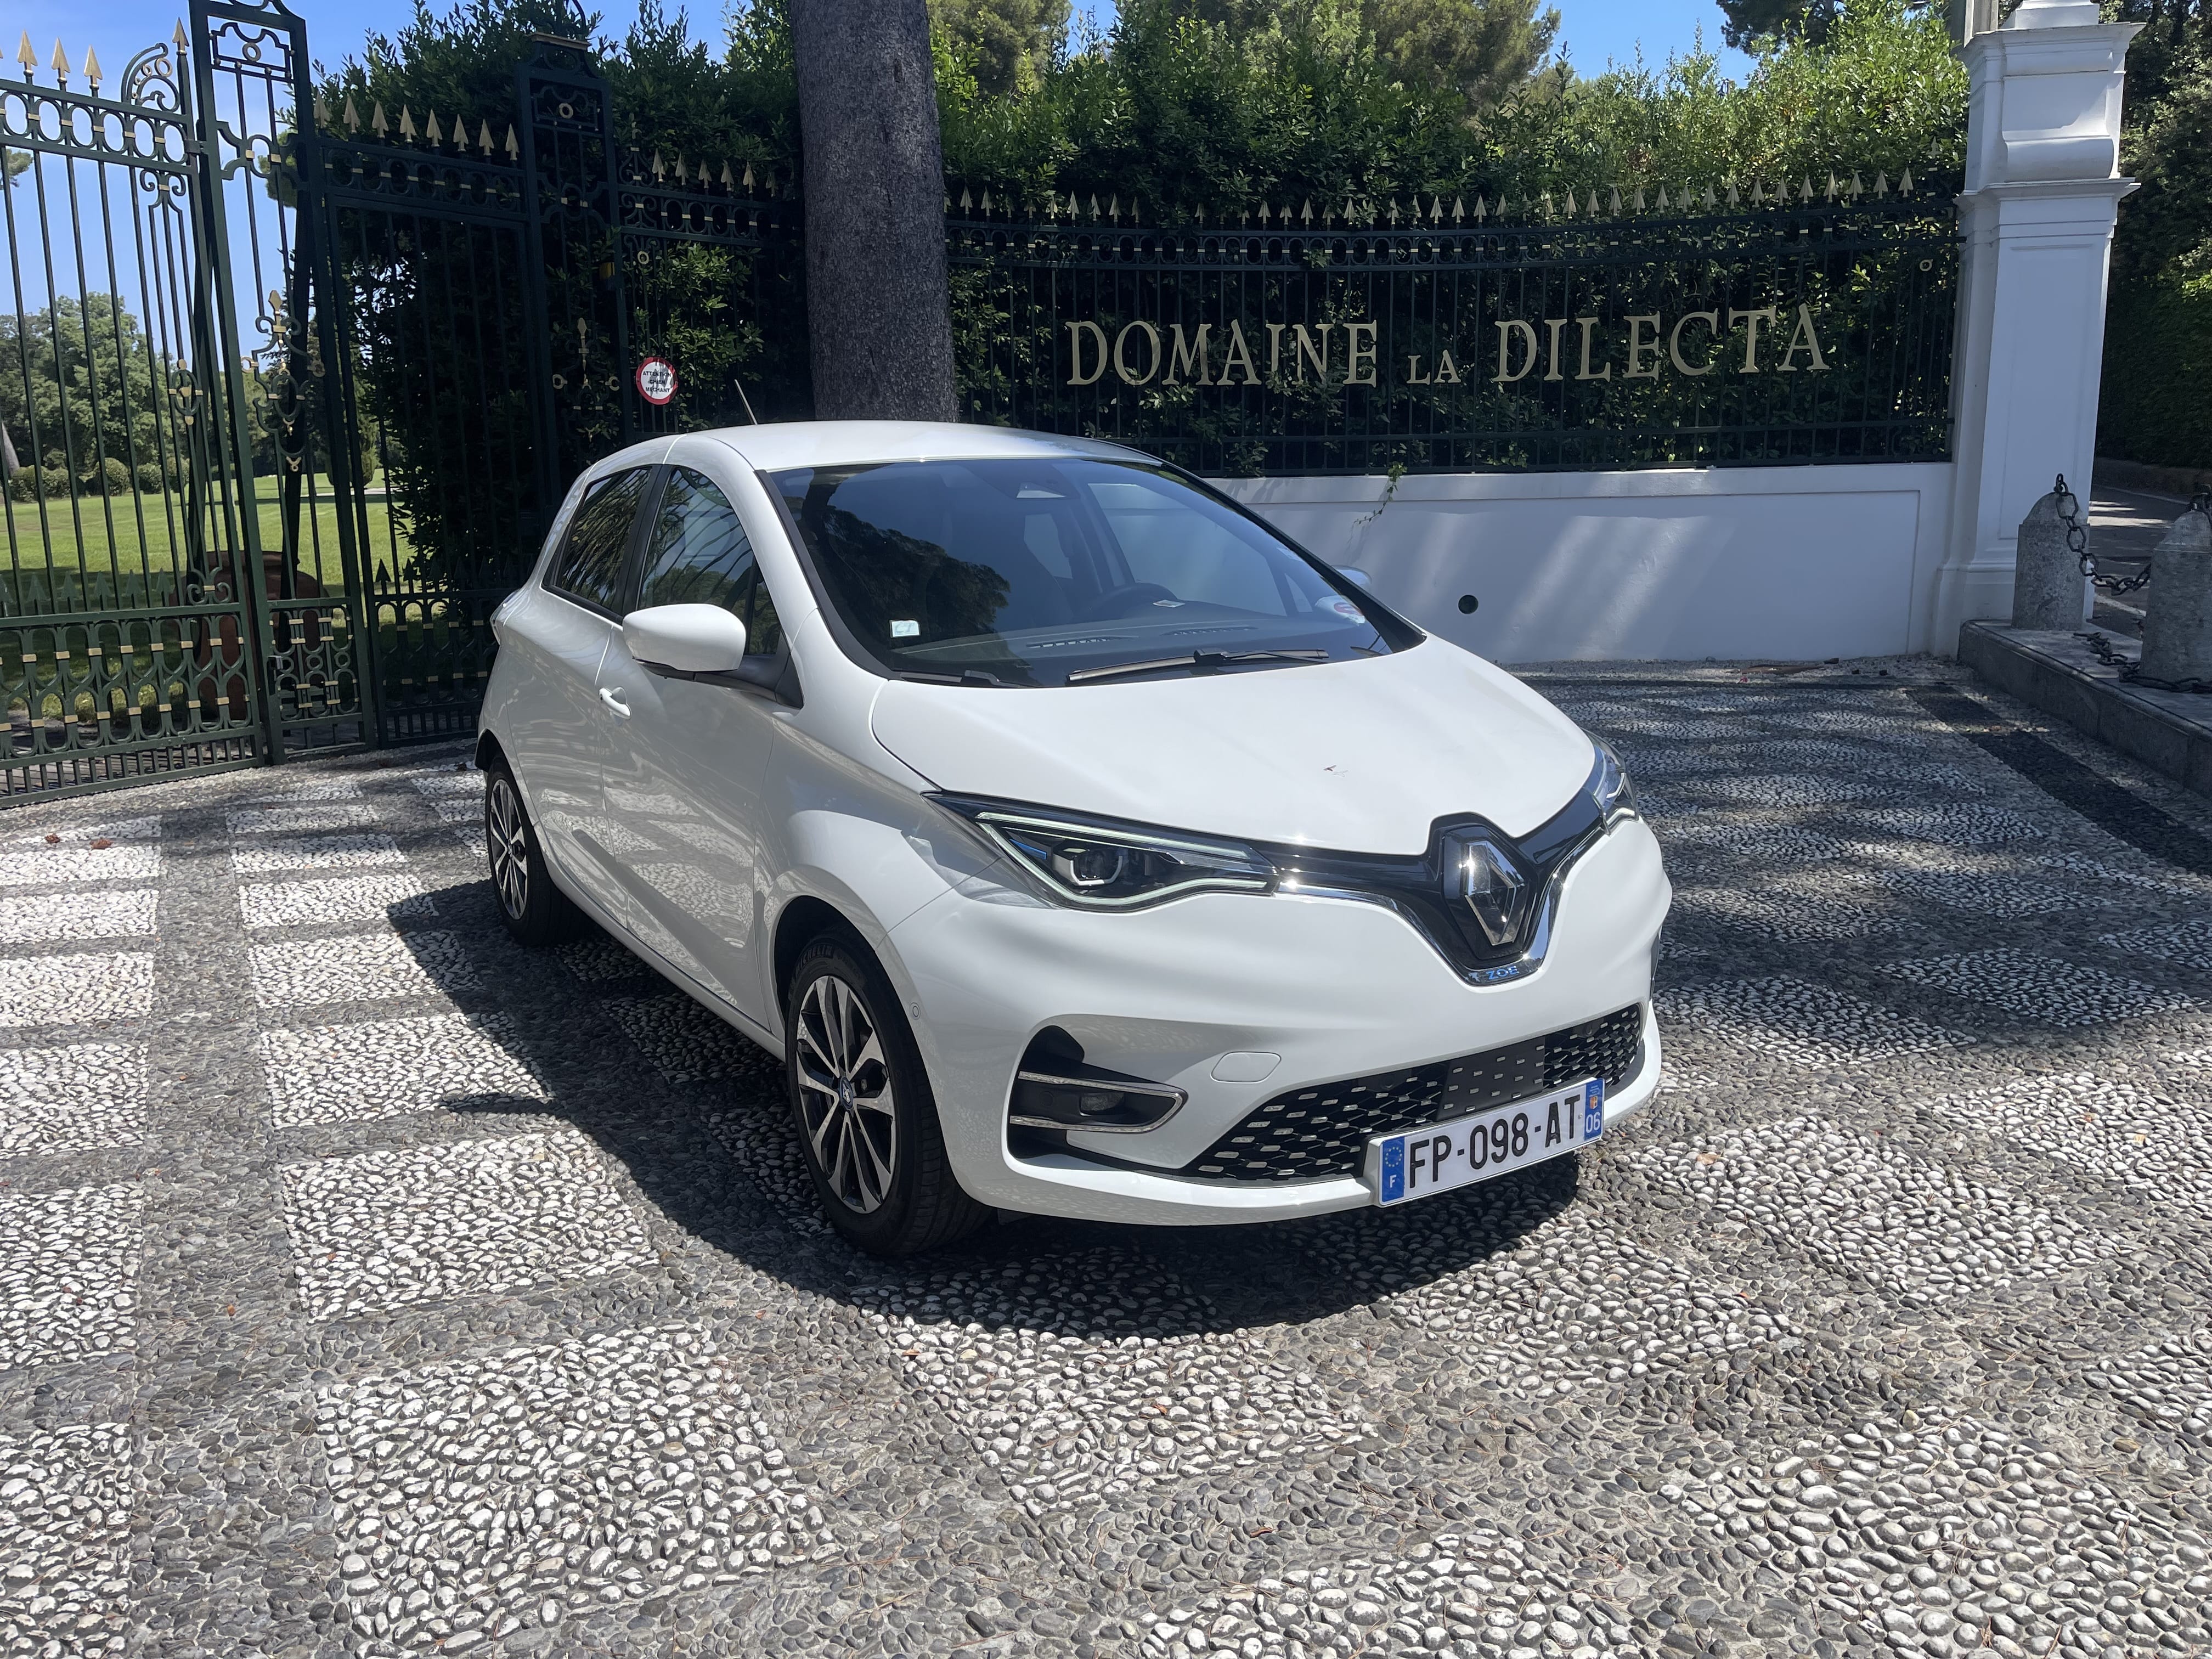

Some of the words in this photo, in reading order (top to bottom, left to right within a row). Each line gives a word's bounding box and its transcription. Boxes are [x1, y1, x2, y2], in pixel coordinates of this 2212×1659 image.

[1065, 319, 1376, 387] DOMAINE
[1407, 349, 1462, 385] LA
[1491, 303, 1830, 382] DILECTA
[1486, 966, 1520, 980] ZOE
[1585, 1111, 1601, 1133] 06
[1409, 1094, 1580, 1188] FP-098-AT
[1389, 1174, 1397, 1188] F
